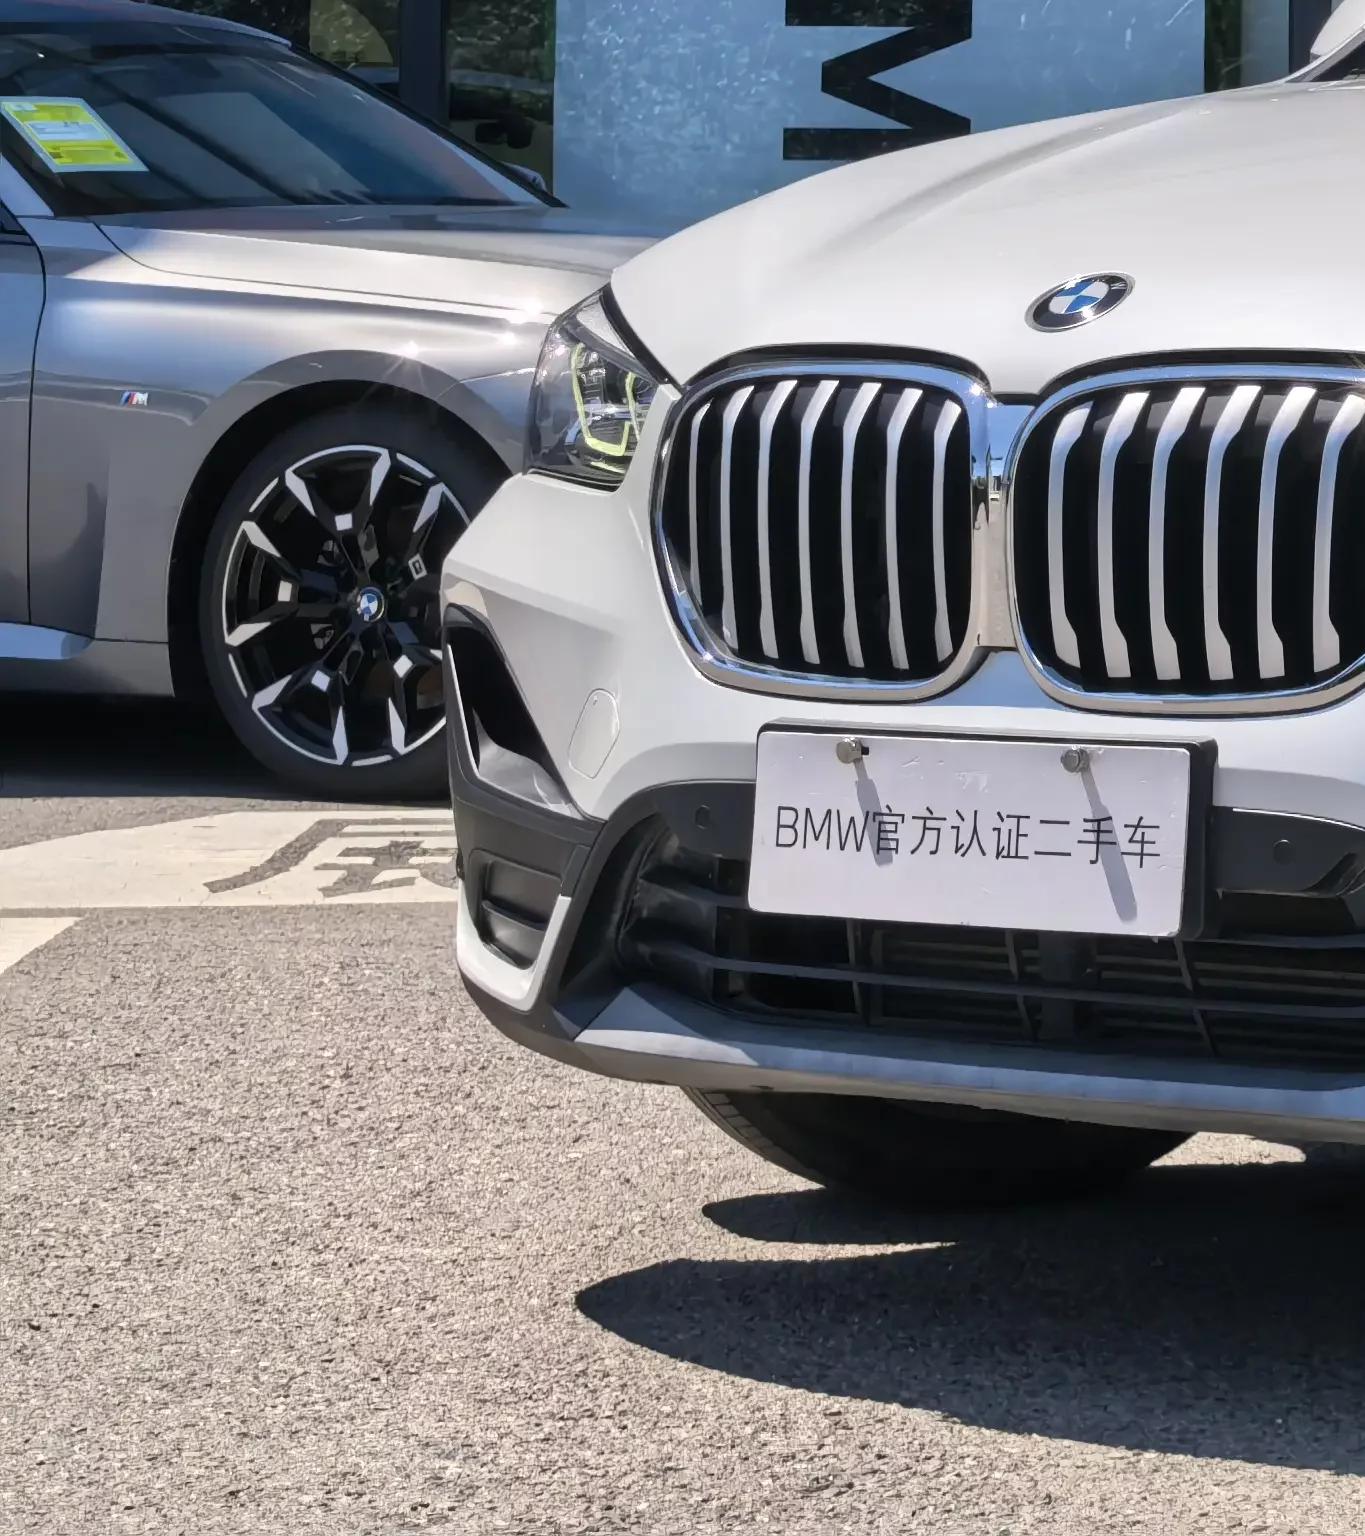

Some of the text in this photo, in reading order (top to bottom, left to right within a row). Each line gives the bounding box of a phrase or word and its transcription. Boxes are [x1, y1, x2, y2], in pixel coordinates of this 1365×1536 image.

[774, 804, 1162, 869] BMW官方认证二手车
